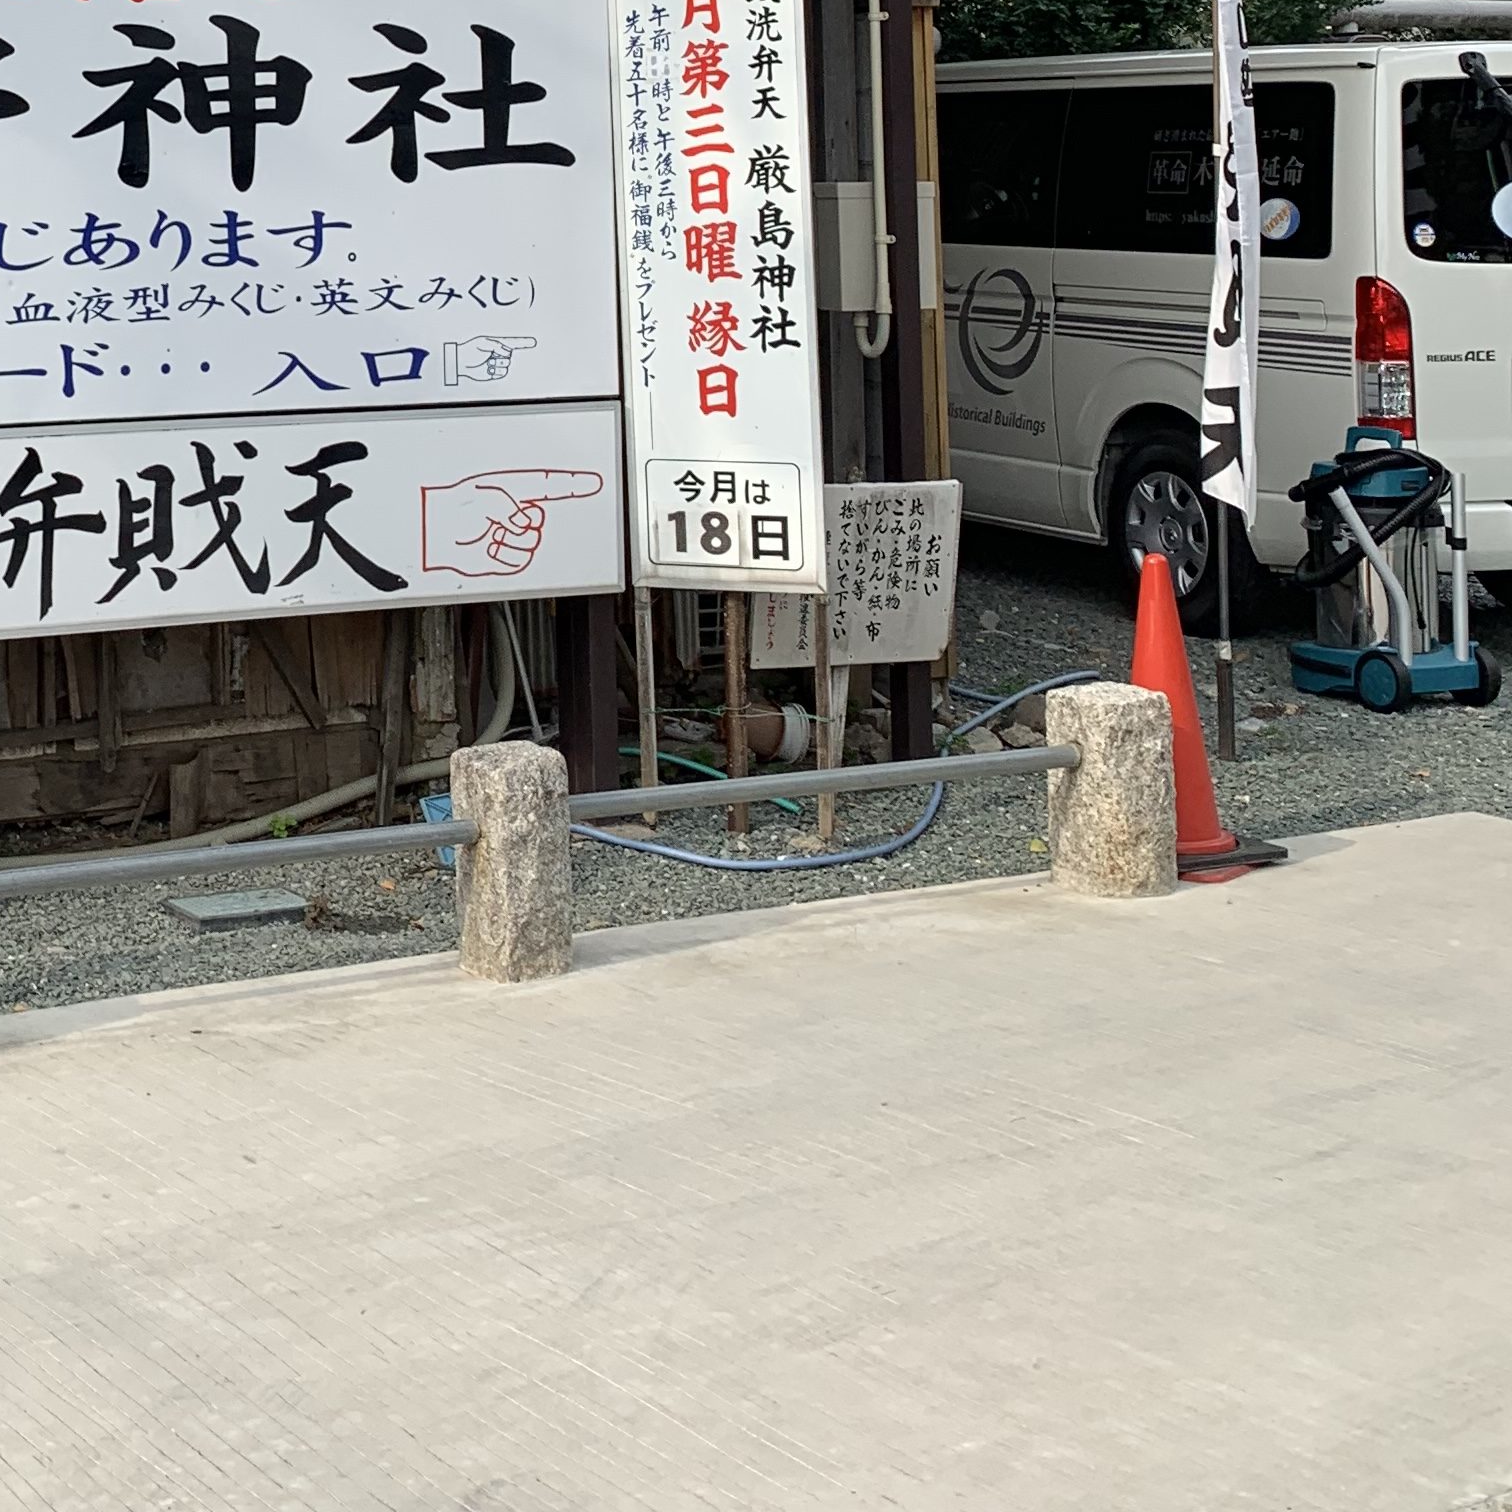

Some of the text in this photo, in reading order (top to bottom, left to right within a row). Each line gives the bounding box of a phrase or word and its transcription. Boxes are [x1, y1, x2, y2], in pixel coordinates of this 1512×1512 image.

[744, 144, 802, 354] 厳島神社
[251, 348, 431, 395] 入口
[1426, 350, 1496, 362] REGIUS ACE
[994, 409, 1046, 436] Buildings
[673, 470, 771, 504] 今月は
[667, 510, 790, 561] 18日
[851, 499, 872, 601] すいがら等
[884, 498, 906, 610] ごみ・危険物
[904, 497, 925, 593] 此の場所に
[924, 534, 942, 597] お願い
[832, 499, 857, 641] 捨てないで下さい
